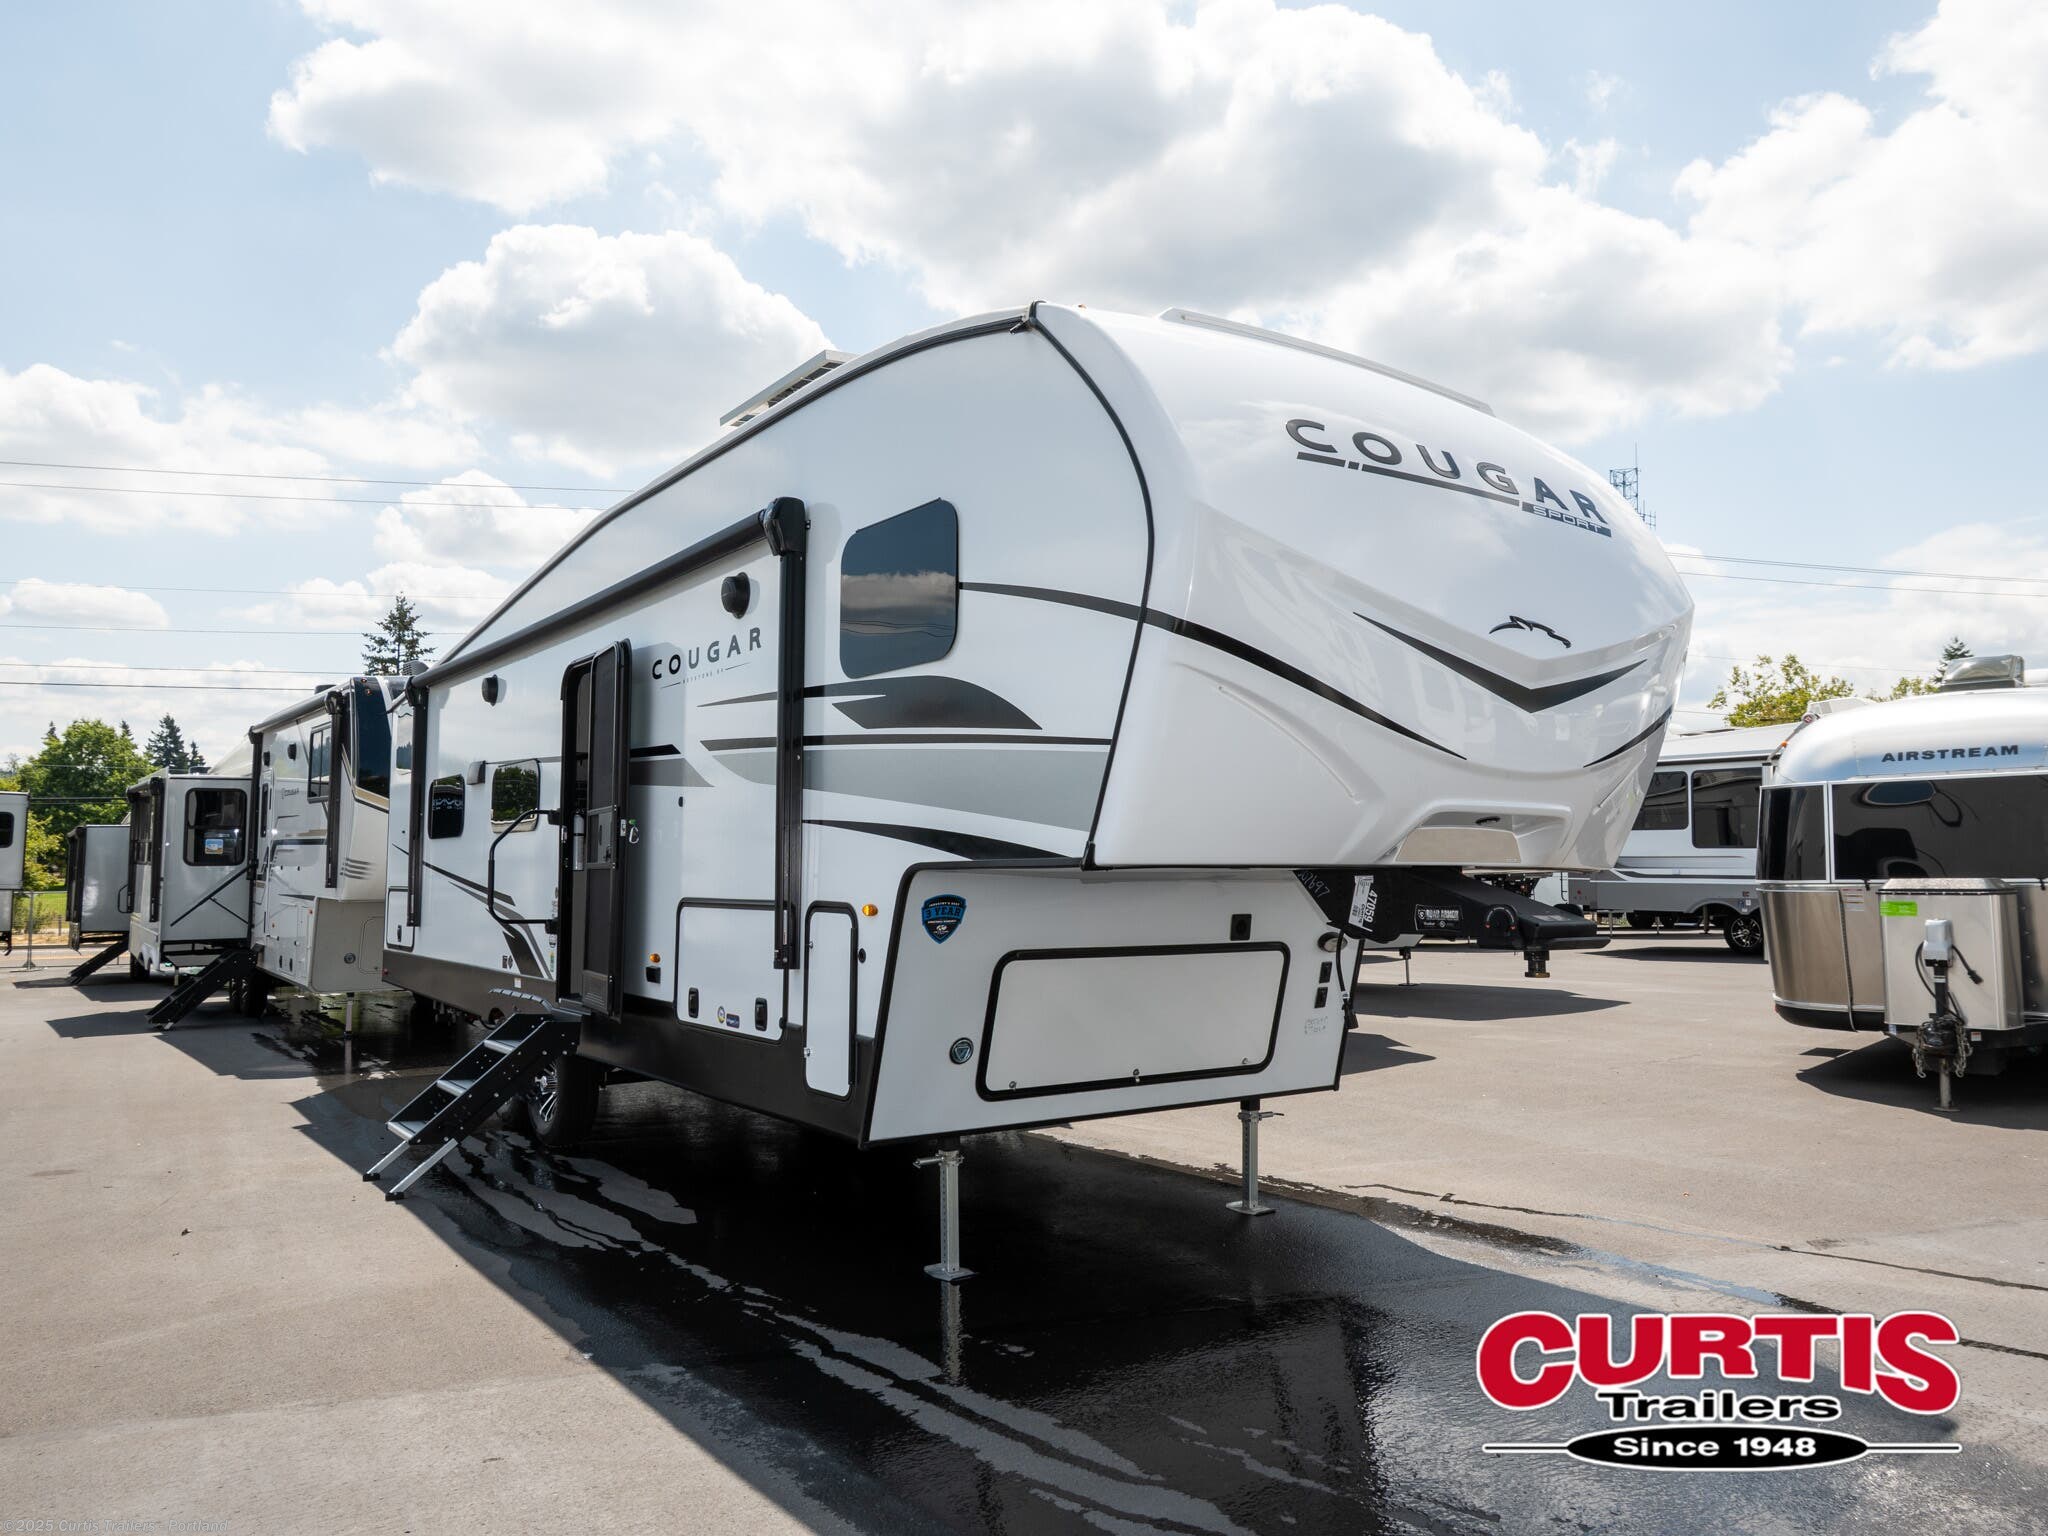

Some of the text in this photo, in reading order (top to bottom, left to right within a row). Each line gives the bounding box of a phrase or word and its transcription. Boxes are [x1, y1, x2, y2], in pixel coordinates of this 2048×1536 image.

[1285, 418, 1608, 525] COUGAR
[1532, 505, 1605, 534] SPORT
[652, 627, 762, 680] COUGAR
[1881, 744, 2019, 763] AIRSTREAM
[935, 906, 961, 917] YEAR
[1363, 889, 1378, 923] 47059
